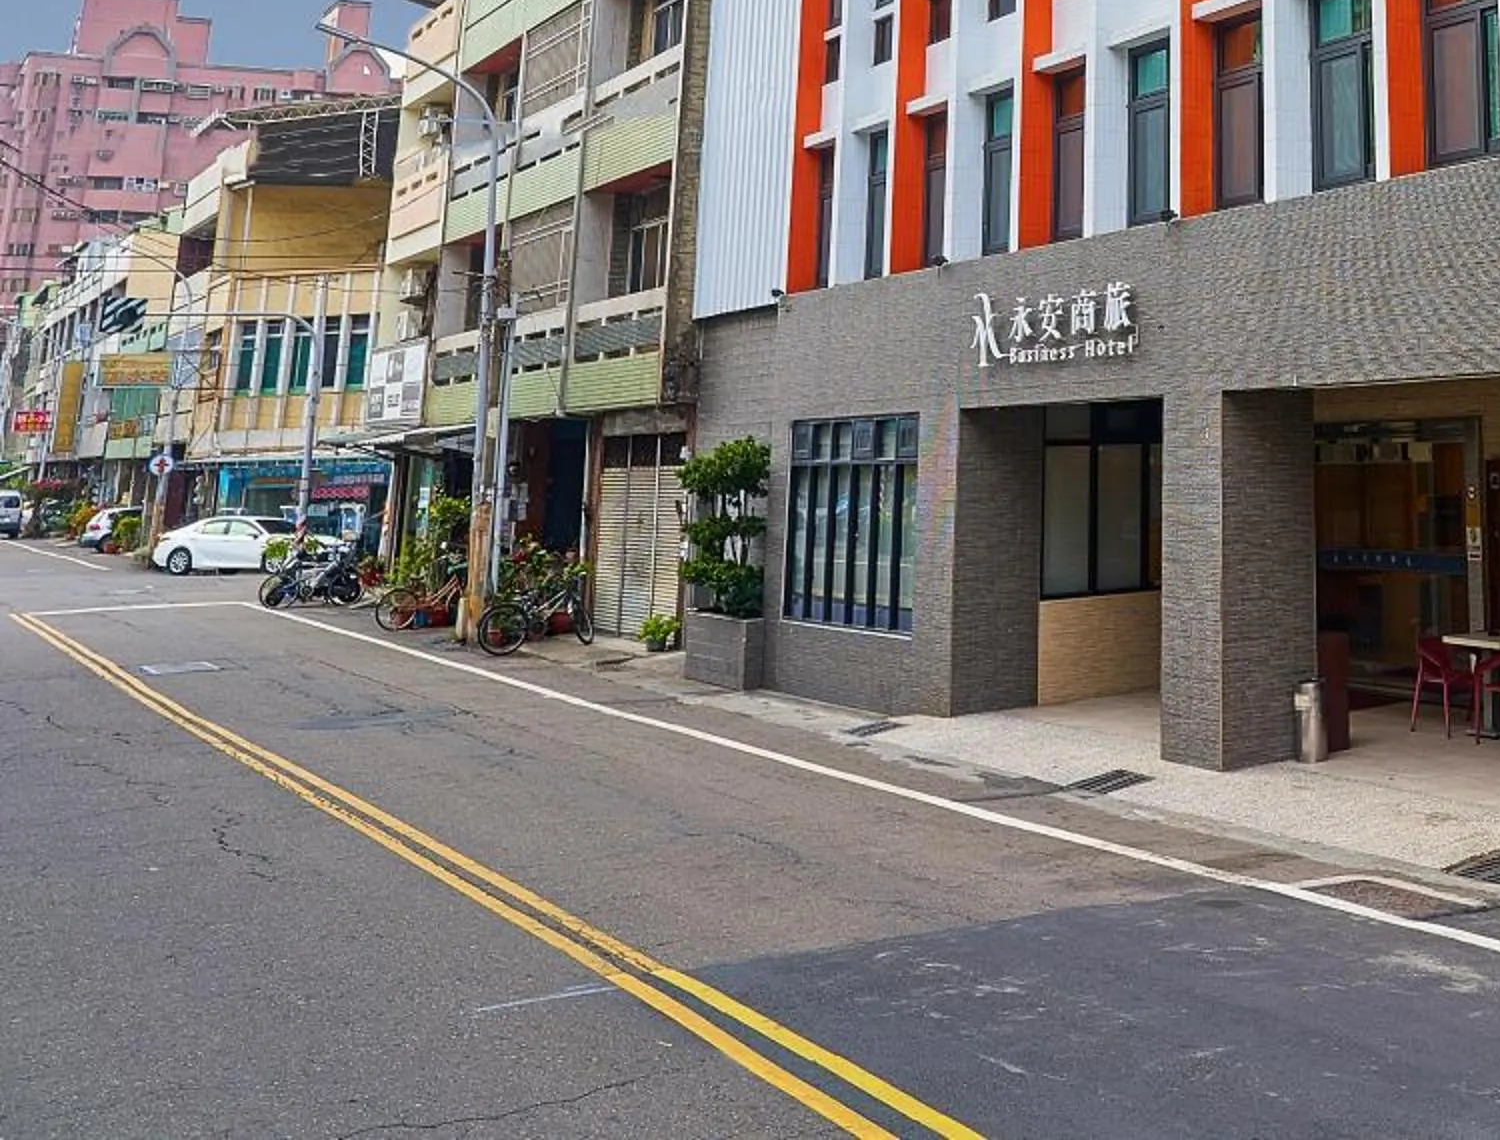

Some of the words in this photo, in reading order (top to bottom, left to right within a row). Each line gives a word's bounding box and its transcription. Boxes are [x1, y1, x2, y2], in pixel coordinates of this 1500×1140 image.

[1008, 281, 1132, 343] 永安商旅
[1009, 344, 1076, 364] Business
[1085, 333, 1135, 358] Hotel
